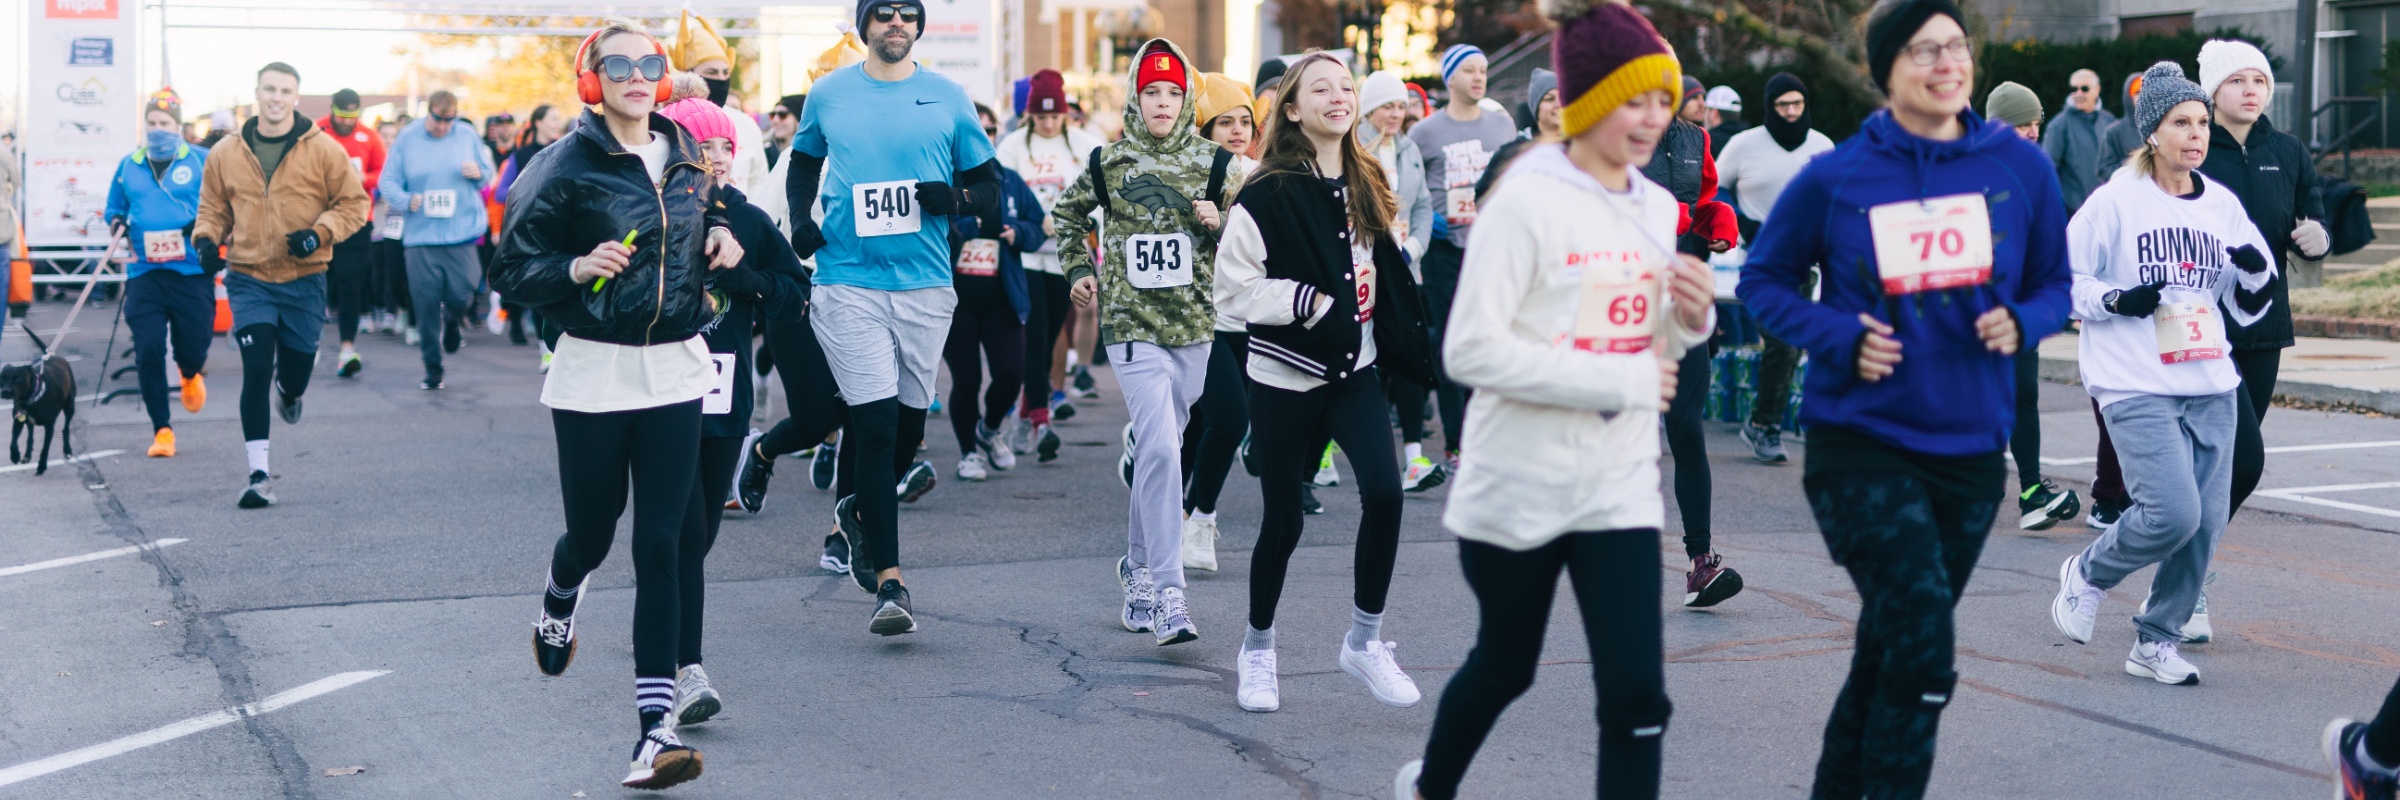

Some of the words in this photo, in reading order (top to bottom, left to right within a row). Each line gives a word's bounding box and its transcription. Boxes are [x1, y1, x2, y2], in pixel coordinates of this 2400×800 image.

[428, 196, 450, 208] 546
[864, 185, 910, 220] 540
[152, 242, 179, 253] 253
[963, 250, 995, 263] 244
[1136, 239, 1181, 272] 543
[1910, 227, 1964, 261] 70
[2137, 227, 2224, 270] RUNNING
[1608, 294, 1648, 325] 69
[2186, 321, 2203, 342] 3
